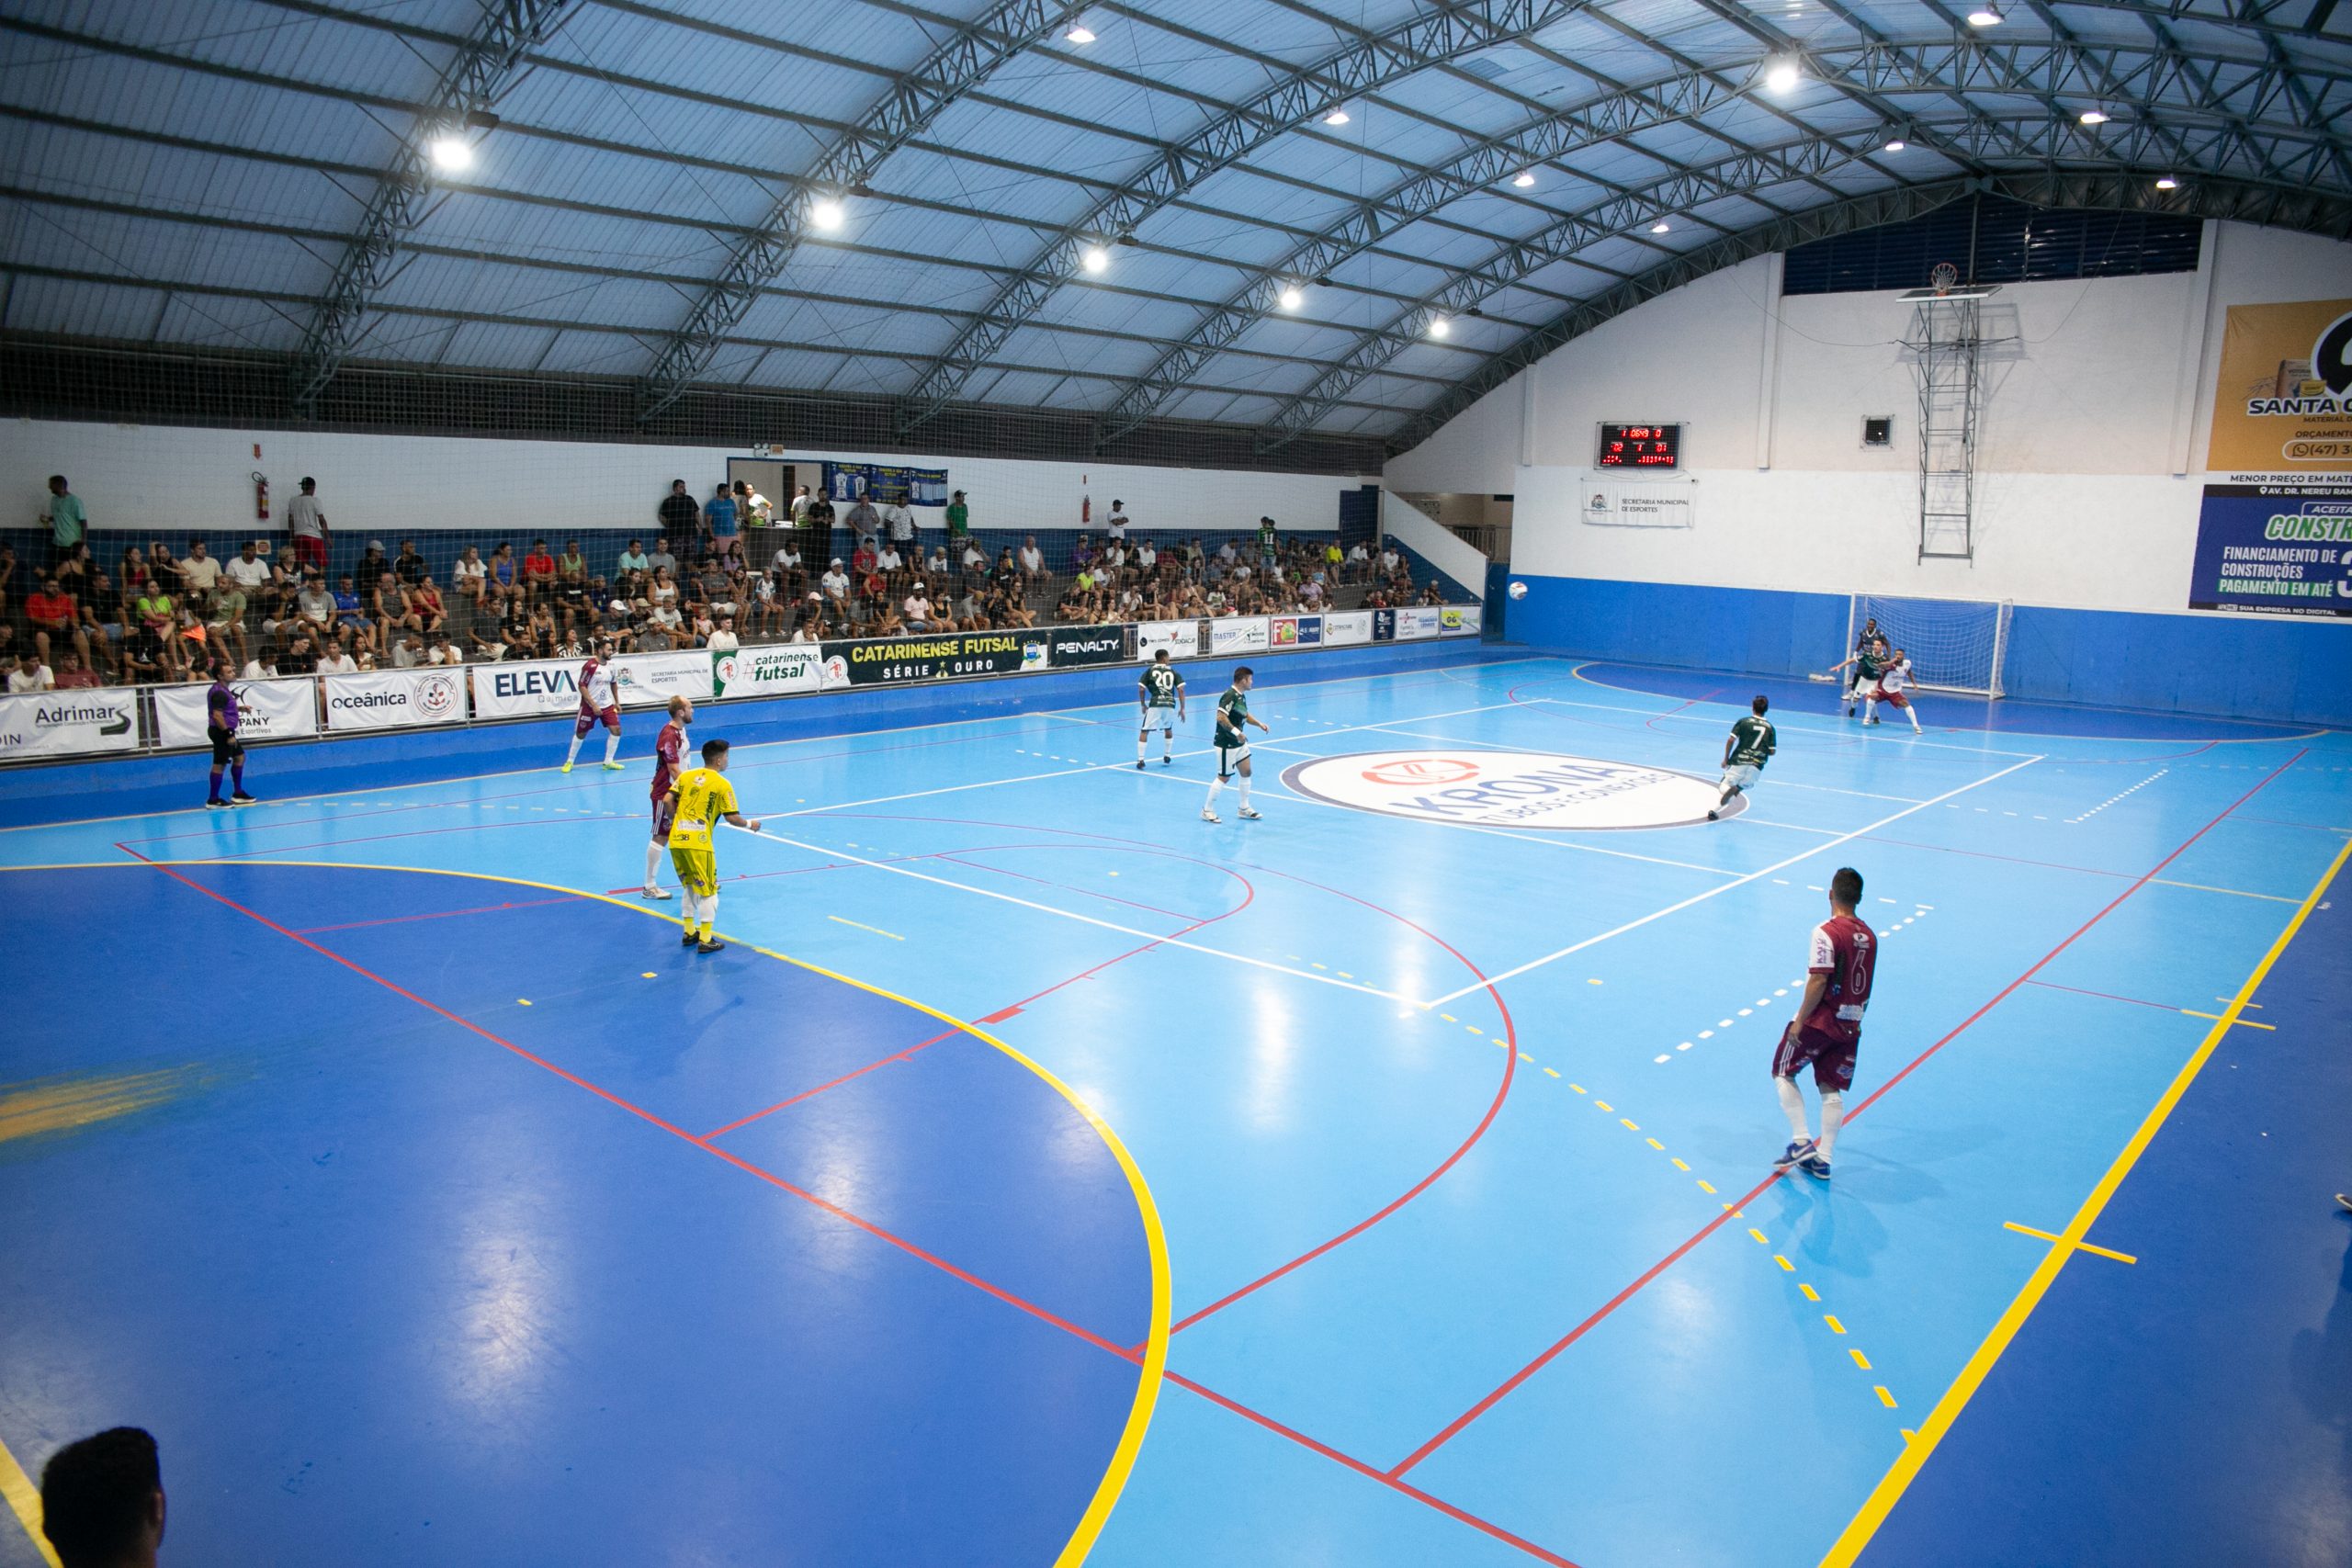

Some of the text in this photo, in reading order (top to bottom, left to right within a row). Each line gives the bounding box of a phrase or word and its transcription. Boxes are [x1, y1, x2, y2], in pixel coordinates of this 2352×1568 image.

[2247, 398, 2337, 414] SANTA
[2310, 444, 2352, 457] (47) 3
[2231, 475, 2267, 483] MENOR
[2270, 475, 2304, 485] PREÇO
[2308, 475, 2324, 483] EM
[2267, 487, 2282, 495] AV.
[2284, 487, 2299, 495] DR.
[2301, 488, 2332, 496] NEREU
[2223, 547, 2319, 563] FINANCIAMENTO
[2321, 549, 2337, 563] DE
[2222, 562, 2303, 581] CONSTRUÇÕES
[2219, 579, 2334, 597] PAGAMENTO EM ATÉ
[852, 637, 1019, 663] CATARINENSE FUTSAL
[1057, 638, 1119, 654] PENALTY
[755, 653, 819, 665] catarinense
[651, 670, 677, 678] SECRETARIA
[755, 663, 806, 682] futsal
[883, 660, 993, 679] SÉRIE OURO
[495, 670, 577, 697] ELEVA
[1151, 670, 1174, 690] 20
[332, 692, 407, 710] oceânica
[35, 705, 116, 724] Adrimar
[239, 716, 270, 727] PANY
[0, 734, 21, 745] IN
[1753, 725, 1766, 749] 7
[1387, 763, 1638, 816] KRONA
[1850, 949, 1867, 995] 6
